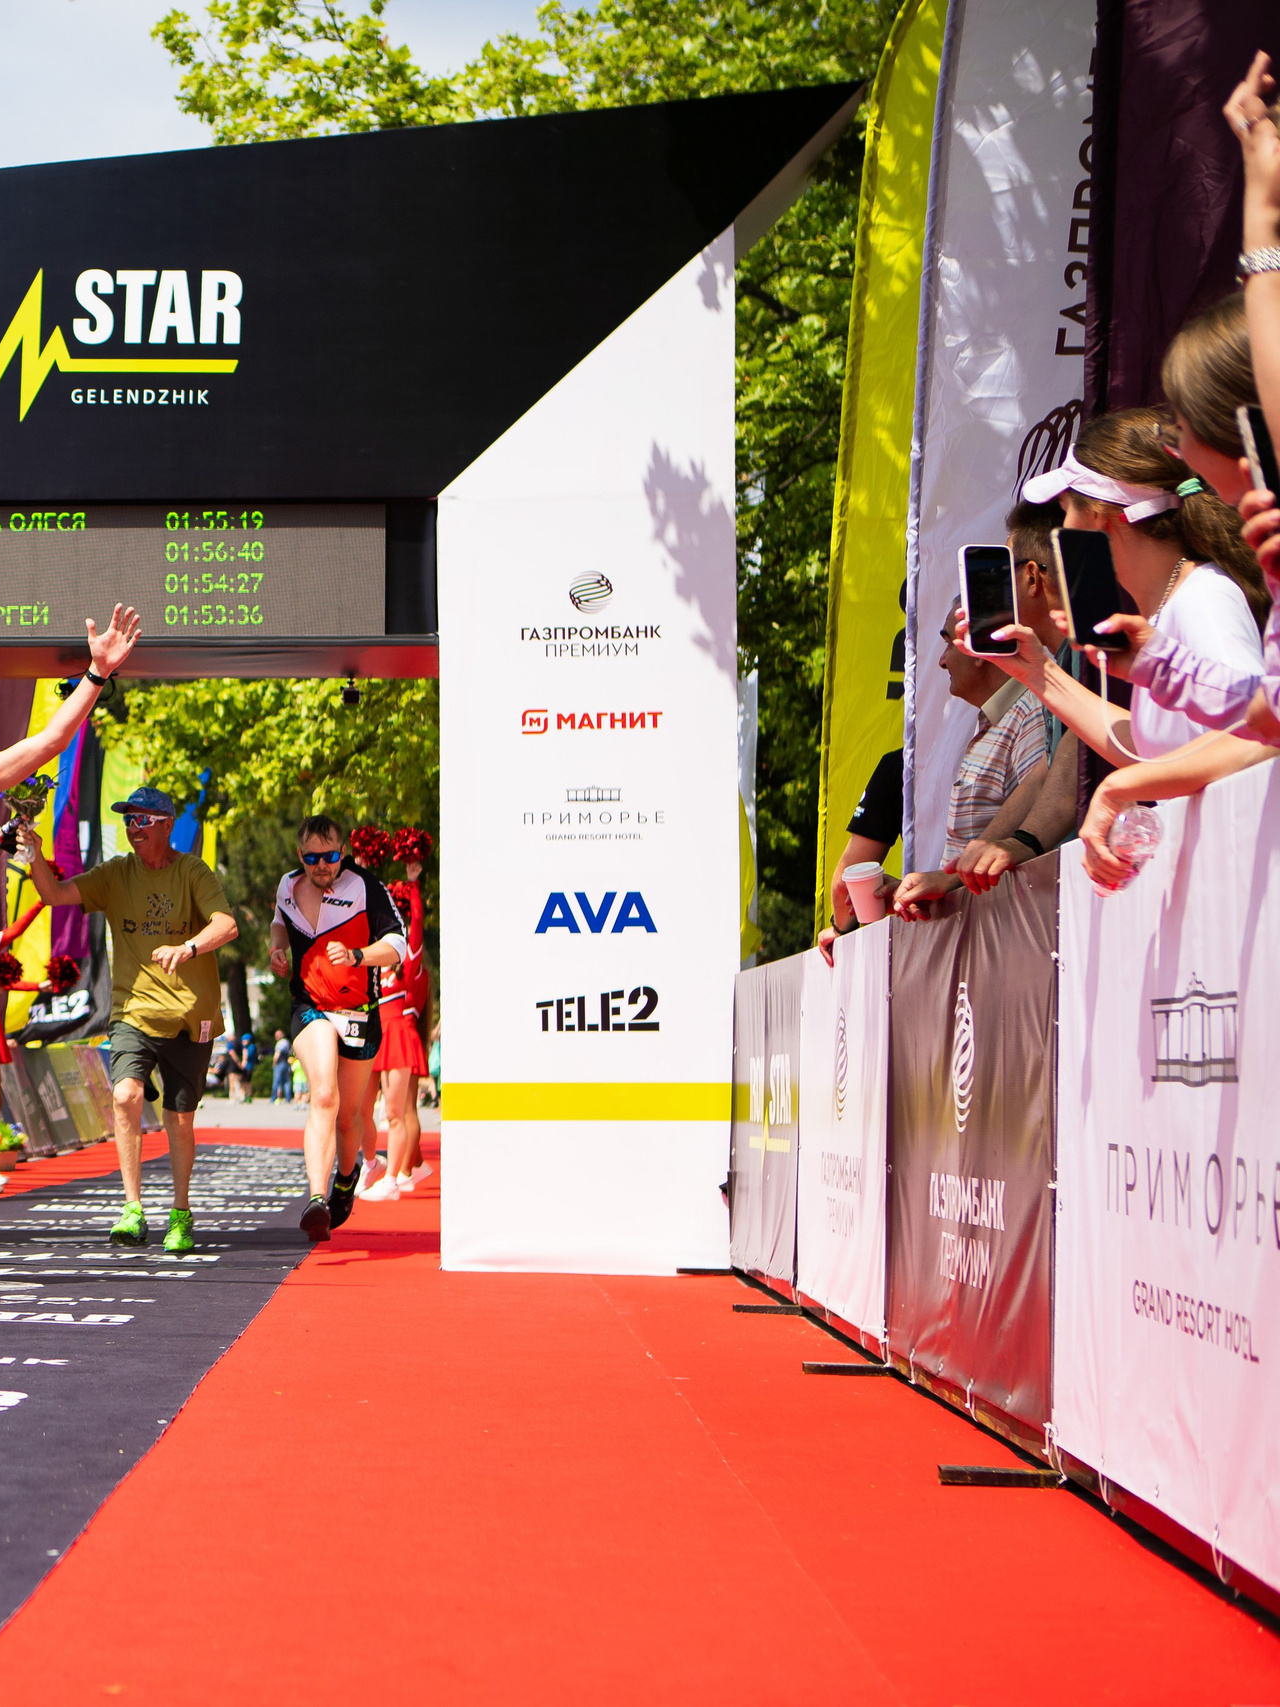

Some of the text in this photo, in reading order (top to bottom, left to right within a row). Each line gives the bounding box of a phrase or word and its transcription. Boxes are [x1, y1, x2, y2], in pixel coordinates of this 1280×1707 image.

[73, 268, 243, 344] STAR
[70, 388, 209, 405] GELENDZHIK
[9, 512, 86, 532] ОЛЕСЯ
[165, 511, 264, 531] 01:55:19
[165, 541, 265, 562] 01:56:40
[164, 573, 264, 594] 01:54:27
[164, 605, 264, 625] 01:53:36
[520, 625, 662, 641] ГАЗПРОМБАНК
[545, 643, 639, 657] ПРЕМИУМ
[556, 712, 663, 730] МАГНИТ
[523, 811, 665, 825] ПРИМОРЬЕ
[545, 833, 644, 841] GRAND RESORT HOTEL
[534, 891, 658, 934] AVA
[535, 986, 660, 1032] TELE2
[769, 1053, 792, 1125] STAR
[1132, 1279, 1173, 1326] GRAND
[1176, 1292, 1221, 1346] RESORT
